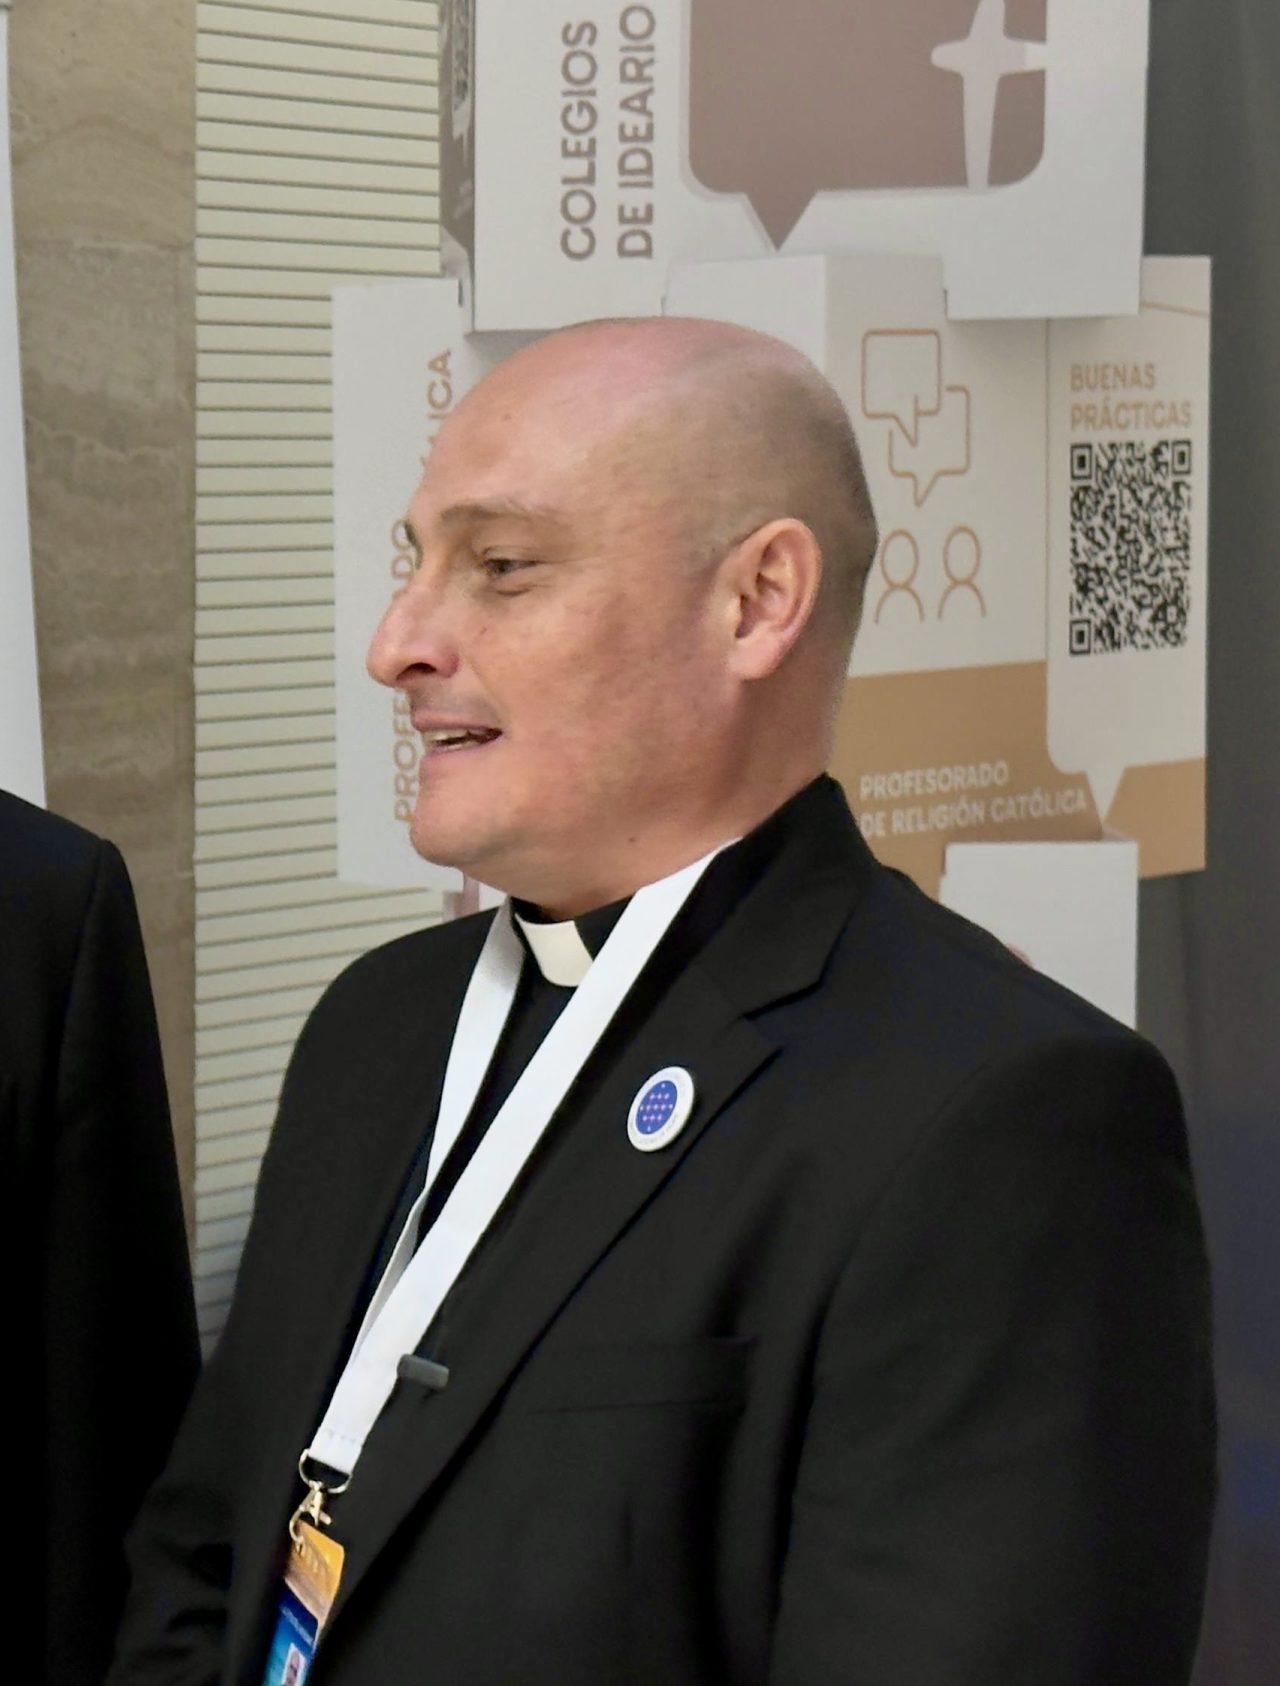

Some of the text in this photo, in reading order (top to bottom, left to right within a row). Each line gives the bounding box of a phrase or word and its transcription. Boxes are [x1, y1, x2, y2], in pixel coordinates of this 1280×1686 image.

[560, 20, 598, 262] COLEGIOS
[616, 4, 656, 260] DE IDEARIO
[1070, 362, 1156, 391] BUENAS
[1070, 393, 1192, 431] PRÁCTICAS
[859, 760, 1010, 798] PROFESORADO
[859, 786, 1088, 836] DE RELIGIÓN CATÓLICA
